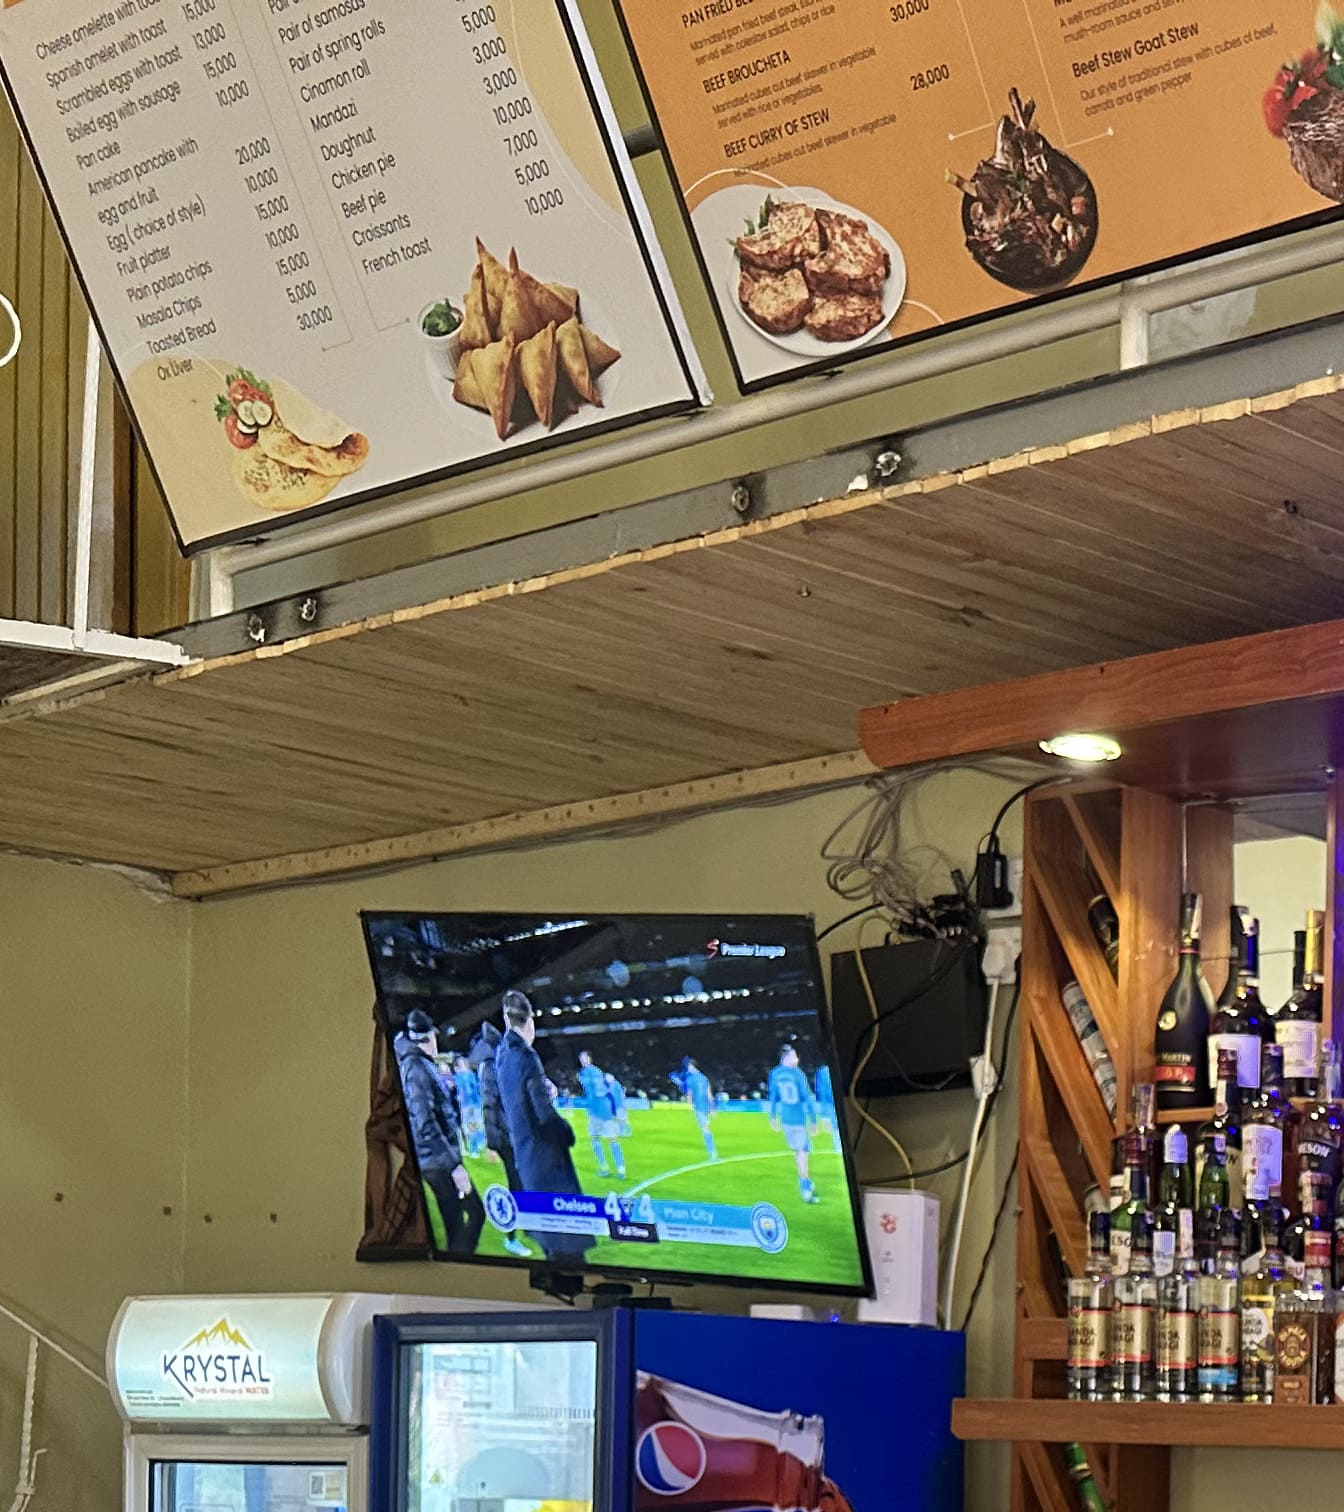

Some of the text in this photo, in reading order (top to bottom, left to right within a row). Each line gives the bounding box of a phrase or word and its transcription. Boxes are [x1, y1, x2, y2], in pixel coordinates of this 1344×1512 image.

[461, 4, 496, 34] 5,000
[682, 0, 733, 28] PAN FRIED
[890, 0, 929, 22] 30,000
[192, 22, 226, 51] 13,000
[278, 14, 314, 44] Pair of
[46, 18, 167, 90] Spanish omelet with toast
[288, 18, 386, 74] Pair of spring rolls
[473, 36, 507, 65] 3,000
[1072, 21, 1199, 78] Beef Stew Goat Stew
[56, 45, 183, 115] Scrambled eggs with toast
[202, 51, 237, 79] 15,000
[300, 58, 371, 103] Cinamon roll
[702, 50, 792, 94] BEEF BROUCHETA
[910, 64, 949, 91] 28,000
[216, 80, 249, 107] 10,000
[483, 67, 517, 96] 3,000
[66, 80, 181, 143] Boiled egg with sausage
[310, 97, 359, 133] Mandazi
[493, 96, 532, 127] 10,000
[320, 126, 377, 161] Doughnut
[503, 128, 538, 157] 7,000
[723, 107, 830, 159] BEEF CURRY OF STEW
[76, 140, 121, 171] Pan cake
[235, 137, 271, 166] 20,000
[88, 137, 199, 198] American pancake with
[245, 167, 279, 194] 10,000
[332, 151, 396, 189] Chicken pie
[515, 159, 550, 187] 5,000
[98, 186, 159, 227] egg and fruit
[255, 195, 289, 222] 15,000
[341, 188, 387, 219] Beef pie
[524, 188, 564, 216] 10,000
[106, 193, 207, 254] Egg of style)
[265, 223, 300, 249] 10,000
[352, 213, 412, 247] Croissants
[117, 244, 172, 277] Fruit platter
[276, 251, 310, 277] 15,000
[362, 237, 432, 275] French toast
[126, 259, 214, 304] Plain potato chips
[286, 280, 316, 305] 5,000
[136, 294, 203, 330] Masala Chips
[297, 305, 333, 331] 30,000
[146, 317, 218, 355] Toasted Bread
[157, 356, 194, 382] Ox Liver
[553, 1195, 598, 1215] Chelsea
[604, 1191, 622, 1222] 4
[638, 1193, 655, 1225] 4
[163, 1354, 271, 1399] KRYSTAL
